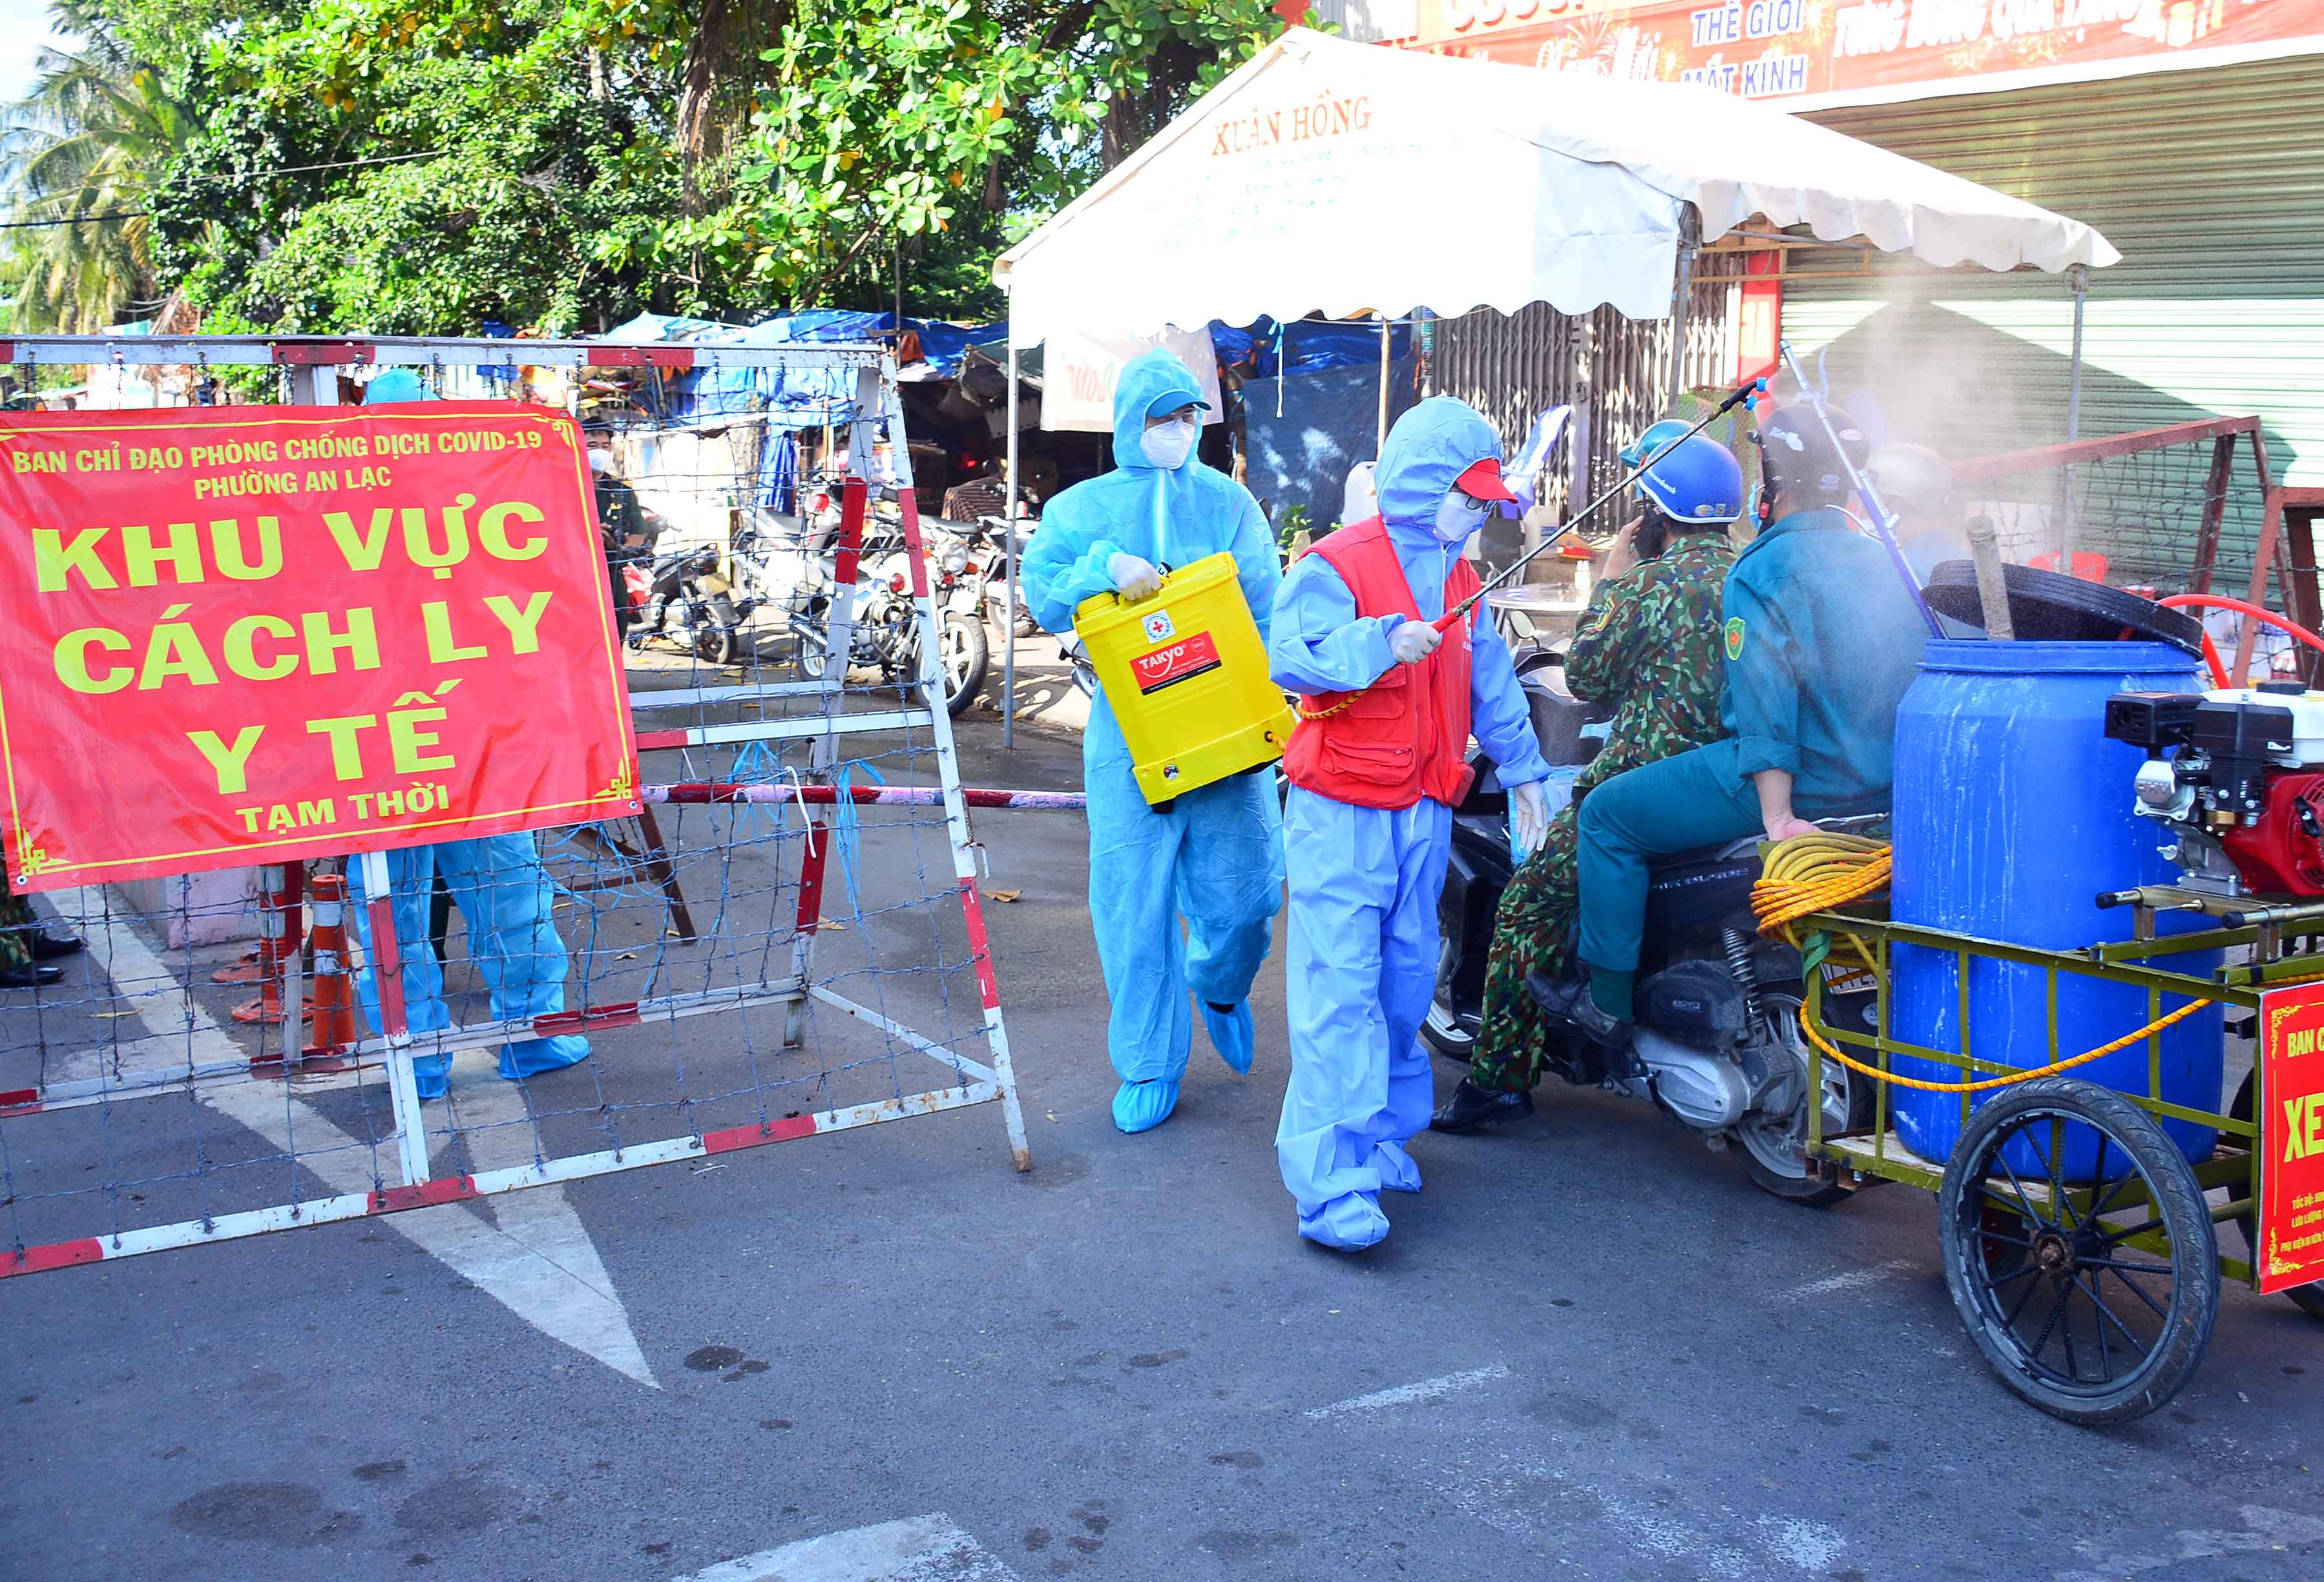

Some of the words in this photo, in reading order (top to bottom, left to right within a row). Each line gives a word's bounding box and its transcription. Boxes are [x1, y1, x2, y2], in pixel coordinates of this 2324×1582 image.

[1211, 107, 1281, 156] XUÂN
[1292, 89, 1371, 142] HỒNG
[13, 451, 67, 473] BAN
[76, 441, 121, 472] CHỈ
[130, 447, 183, 470] ĐẠO
[191, 438, 277, 467] PHÒNG
[285, 430, 368, 460] CHỐNG
[374, 433, 430, 459] DỊCH
[437, 430, 541, 453] COVID-19
[194, 467, 297, 499] PHƯỜNG
[306, 470, 338, 491] AN
[345, 466, 392, 490] LẠC
[32, 516, 283, 592] KHU
[322, 492, 549, 579] VỰC
[54, 603, 381, 694] CÁCH
[421, 591, 553, 664] LY
[187, 725, 265, 794] Y
[306, 679, 463, 781] TẾ
[236, 799, 336, 834] TẠM
[348, 782, 449, 819] THỜI
[2287, 1029, 2314, 1057] BAN
[2284, 1092, 2324, 1163] XE
